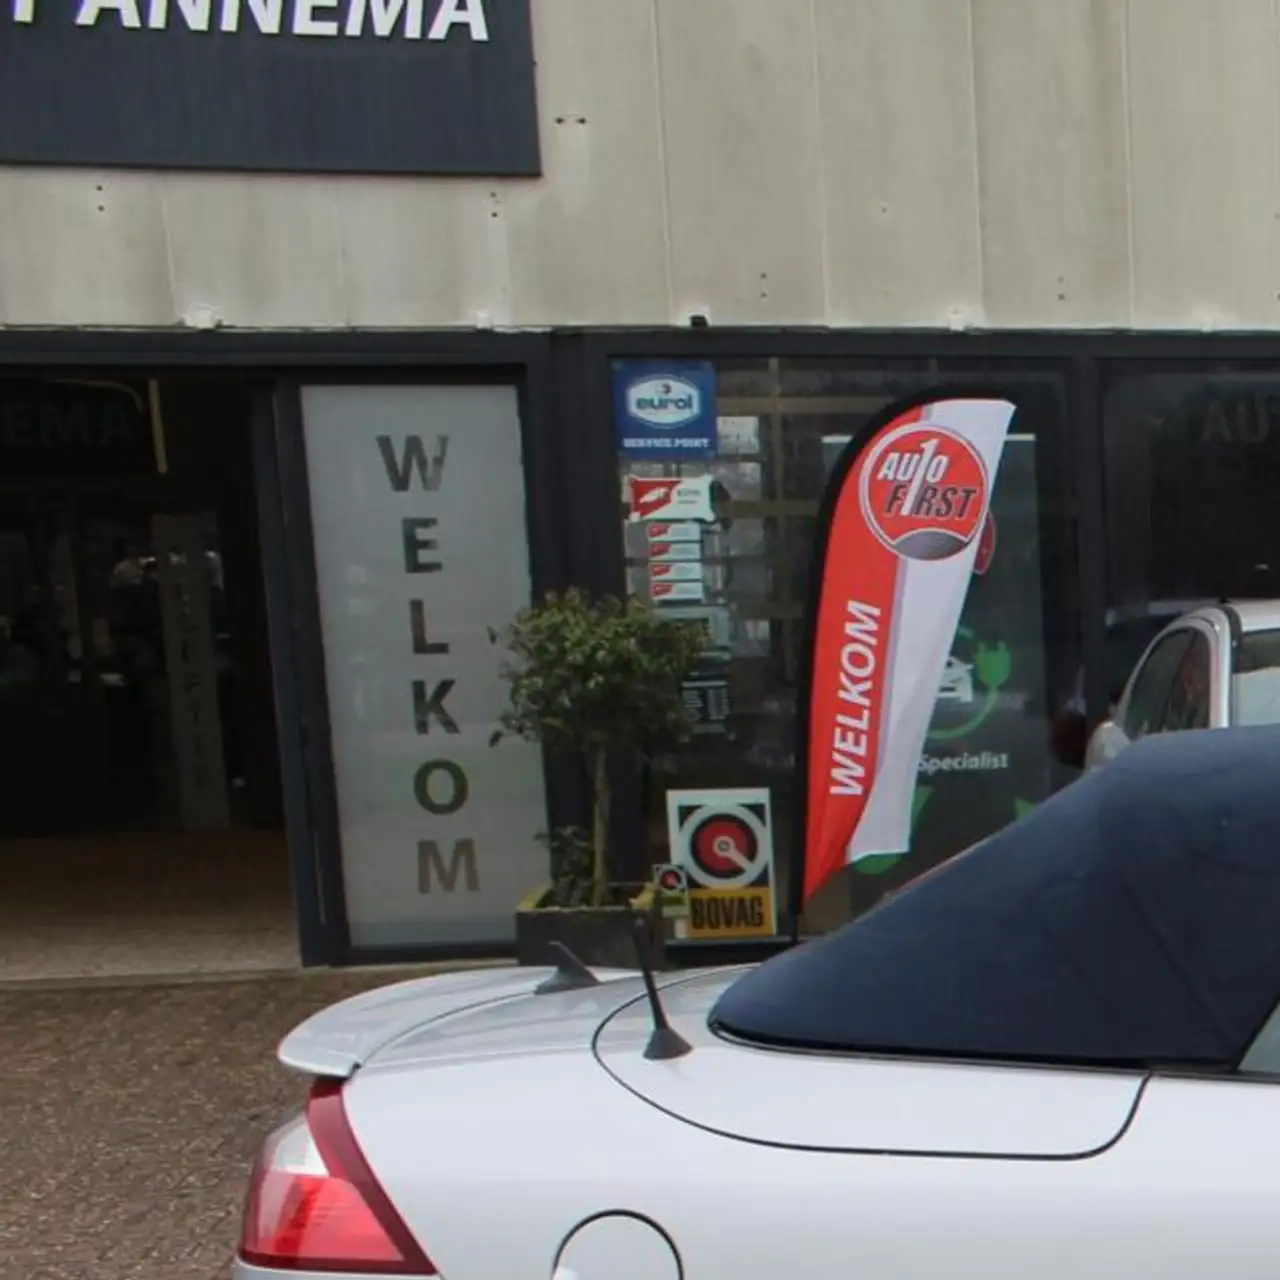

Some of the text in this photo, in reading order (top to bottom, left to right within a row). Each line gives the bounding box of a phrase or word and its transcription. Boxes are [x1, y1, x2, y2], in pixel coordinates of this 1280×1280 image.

[13, 0, 490, 41] ANNEMA
[829, 599, 882, 798] WELKOM
[690, 895, 765, 930] BOVAG
